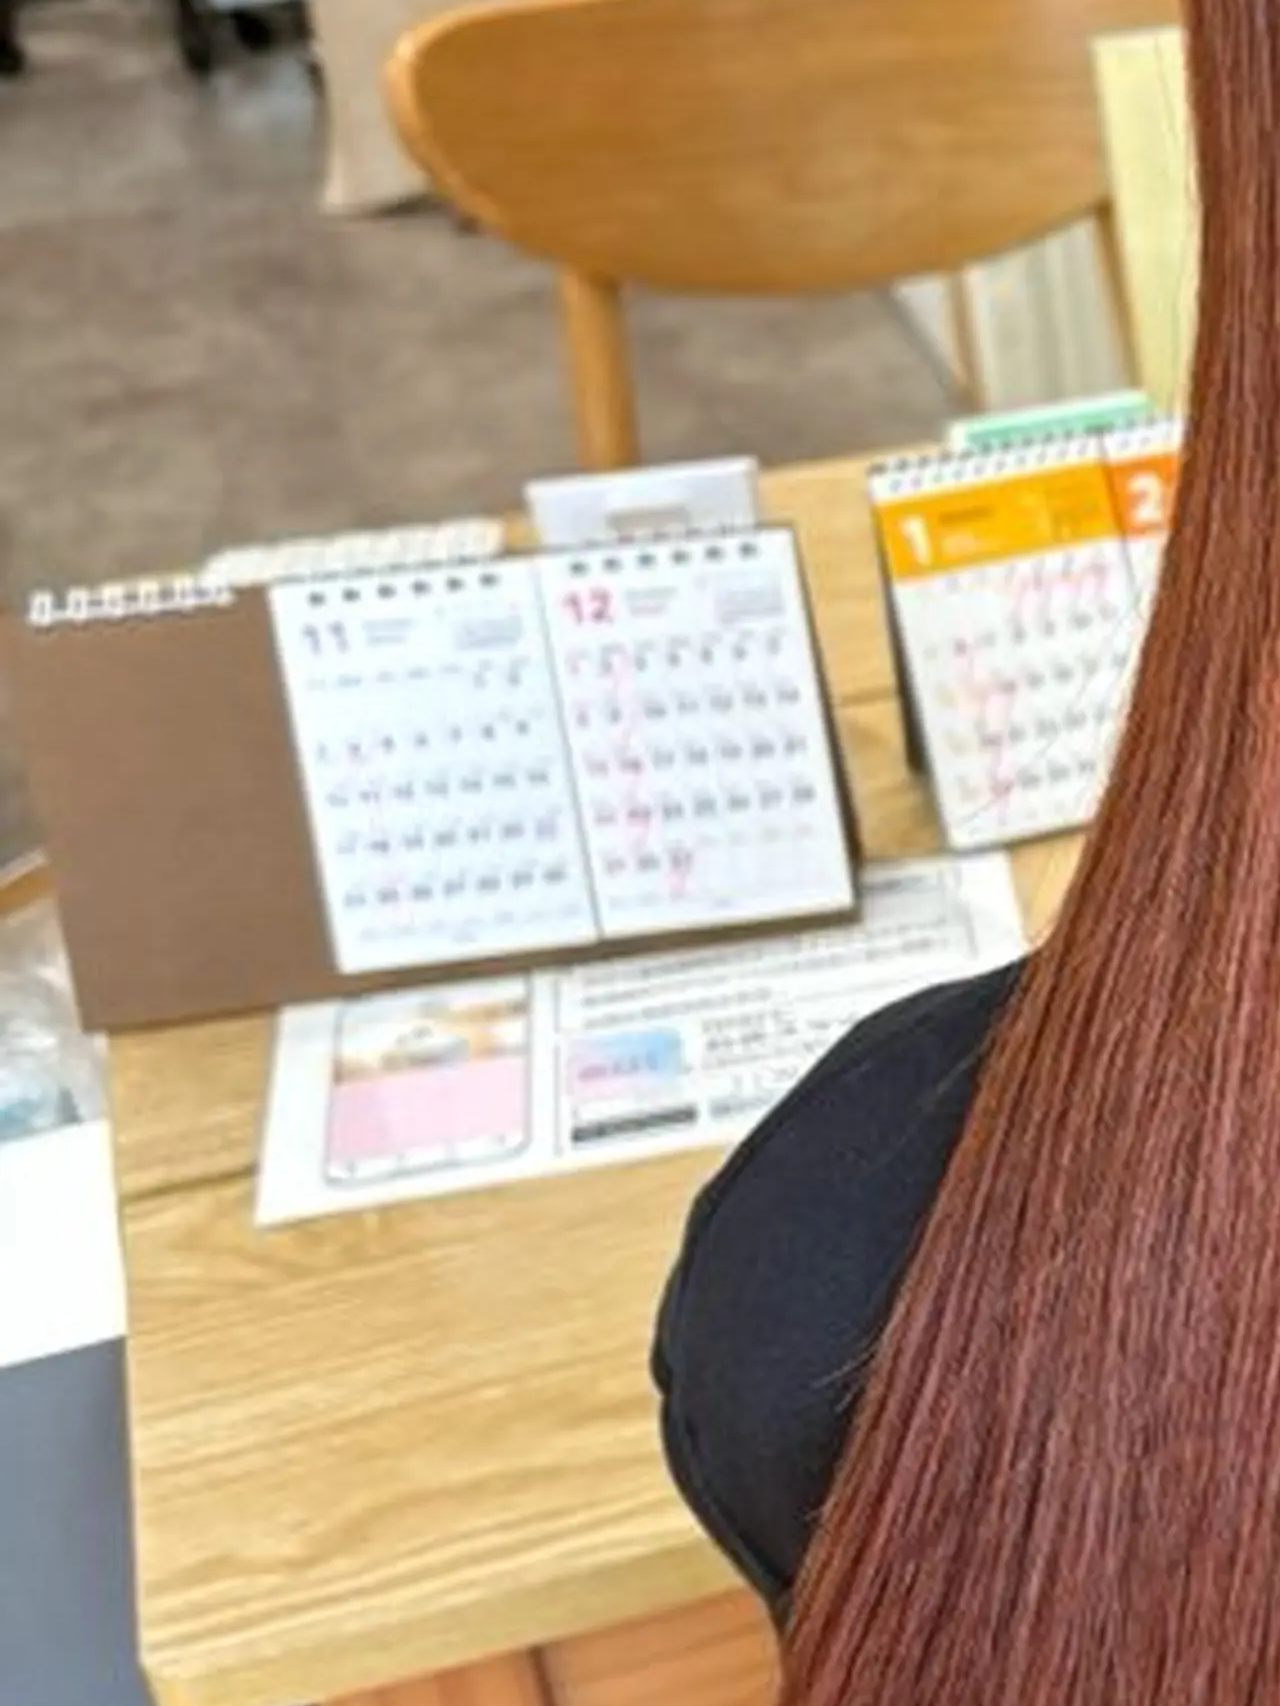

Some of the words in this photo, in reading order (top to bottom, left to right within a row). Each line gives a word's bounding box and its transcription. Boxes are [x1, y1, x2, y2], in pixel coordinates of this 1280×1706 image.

[1126, 470, 1167, 524] 2
[901, 515, 934, 567] 1
[562, 587, 614, 625] 12
[302, 619, 350, 655] 11
